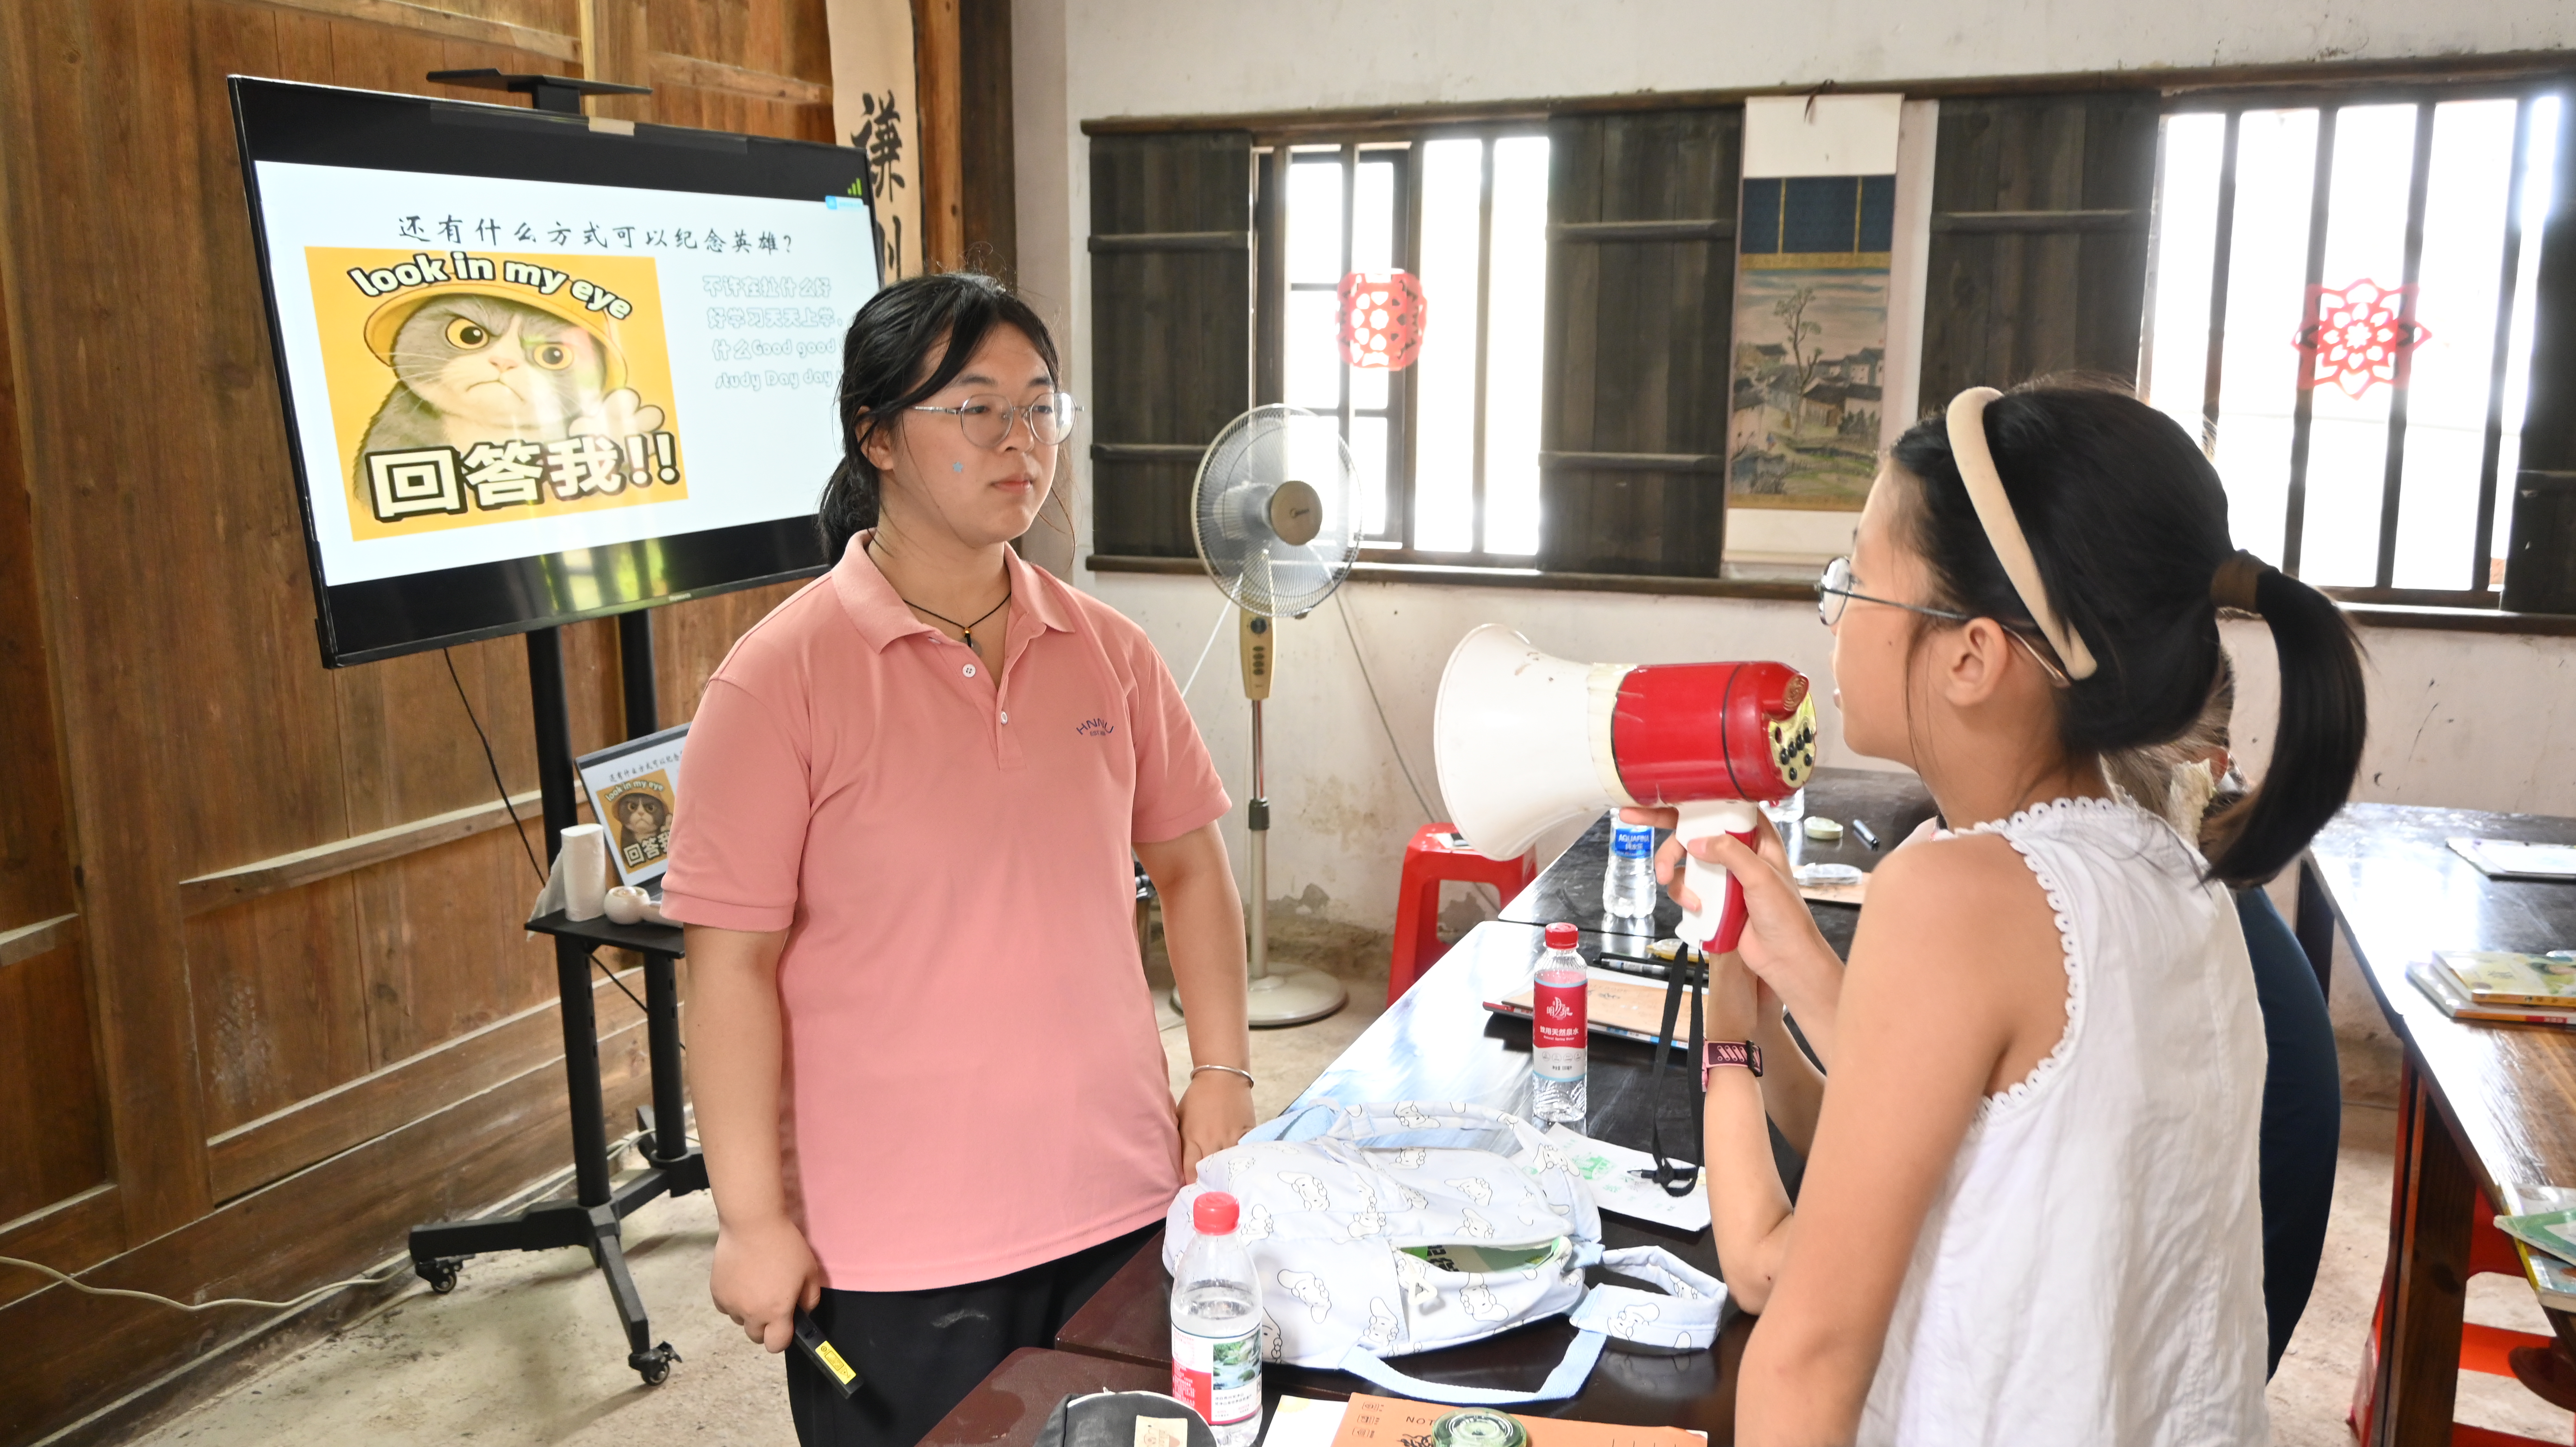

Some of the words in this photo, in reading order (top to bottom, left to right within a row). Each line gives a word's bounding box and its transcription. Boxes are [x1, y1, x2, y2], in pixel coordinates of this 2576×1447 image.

[398, 215, 792, 256] 还有什么方式可以纪念英雄?
[347, 252, 449, 297] look
[450, 251, 495, 281] in
[503, 257, 569, 295] my
[570, 279, 633, 320] eye
[796, 338, 836, 359] good
[715, 371, 762, 391] study
[765, 370, 799, 389] Day
[803, 369, 833, 388] day
[365, 432, 681, 522] 回答我!!
[1076, 717, 1114, 736] HNNU
[605, 785, 623, 801] look
[622, 782, 632, 790] in
[633, 780, 647, 789] my
[648, 781, 664, 792] eye
[1618, 834, 1650, 843] AQUAFINA
[1540, 1025, 1579, 1038] 饮用天然泉水
